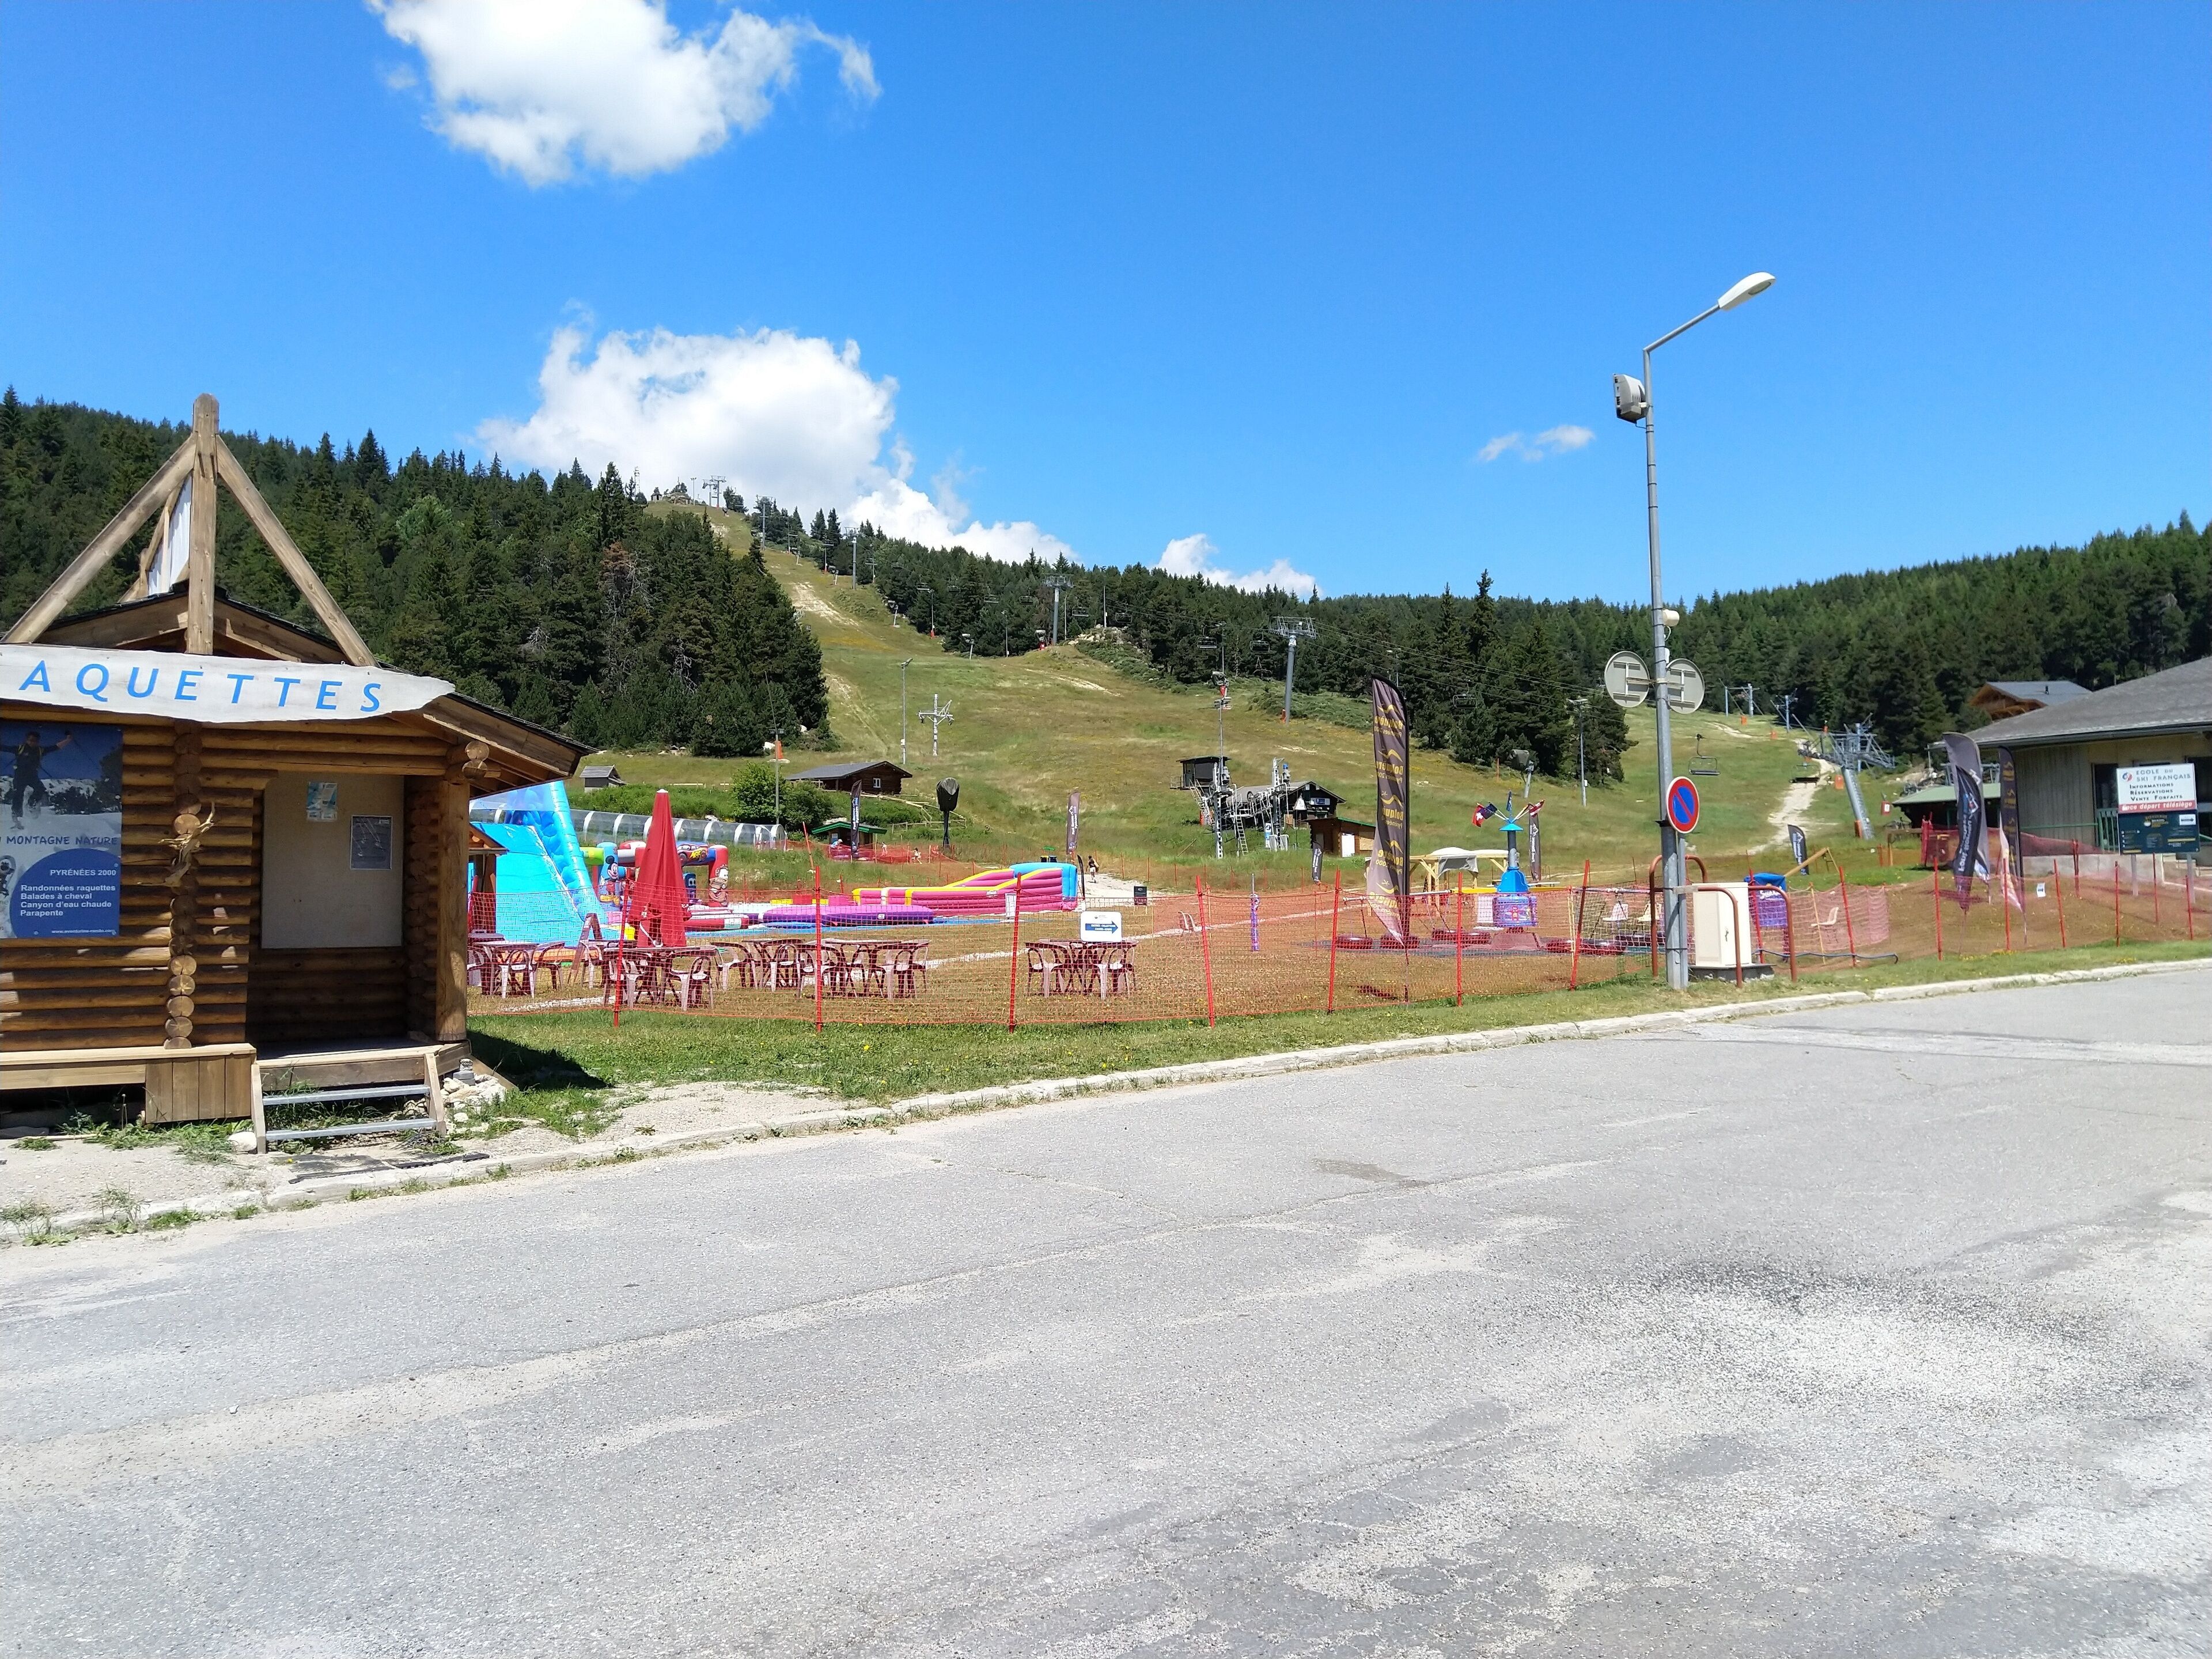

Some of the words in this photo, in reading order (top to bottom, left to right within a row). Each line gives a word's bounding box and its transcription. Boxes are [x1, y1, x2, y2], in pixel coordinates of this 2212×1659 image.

[20, 660, 381, 712] AQUETTES
[6, 836, 70, 845] MONTAGNE
[75, 836, 118, 845] NATURE
[50, 868, 96, 876] PYRÉNÉES
[77, 884, 116, 893] raquettes
[21, 901, 54, 909] Canyon
[20, 910, 63, 918] Parapente
